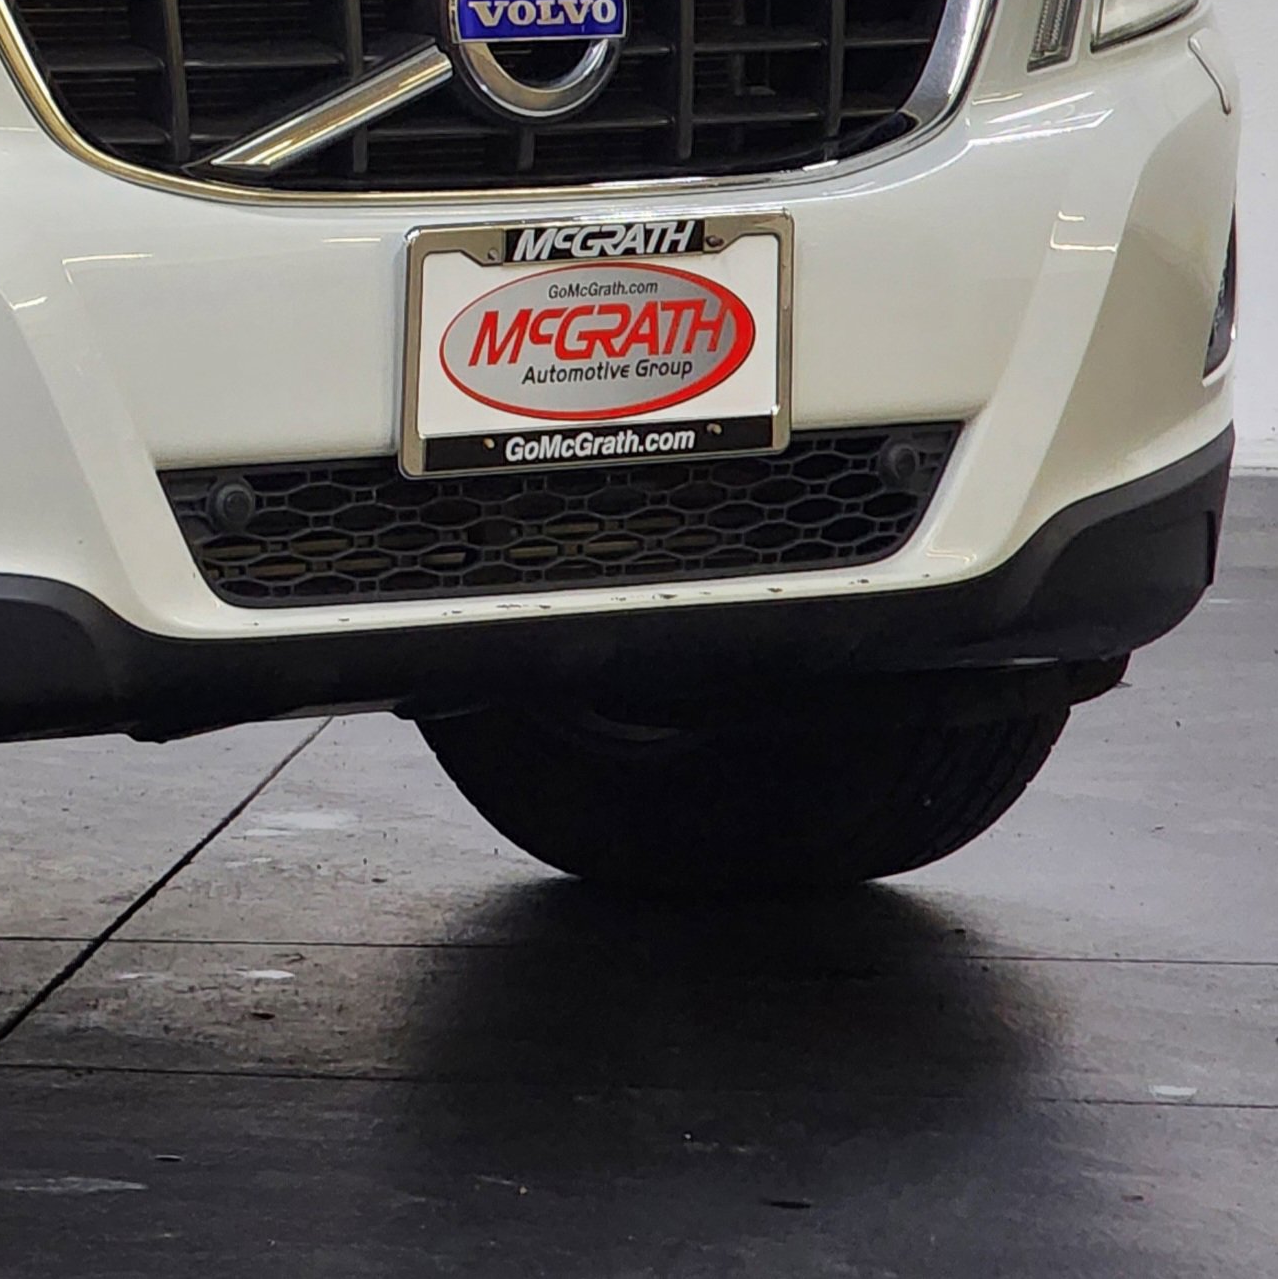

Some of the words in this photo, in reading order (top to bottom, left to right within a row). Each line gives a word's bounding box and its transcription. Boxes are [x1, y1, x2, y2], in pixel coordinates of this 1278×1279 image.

[513, 220, 695, 261] McGRATH
[548, 280, 659, 299] GoMcGrath.com
[468, 298, 728, 367] McGRATH
[522, 361, 630, 385] Automotive
[635, 358, 693, 380] Group
[505, 429, 696, 462] GoMcGrath.com
